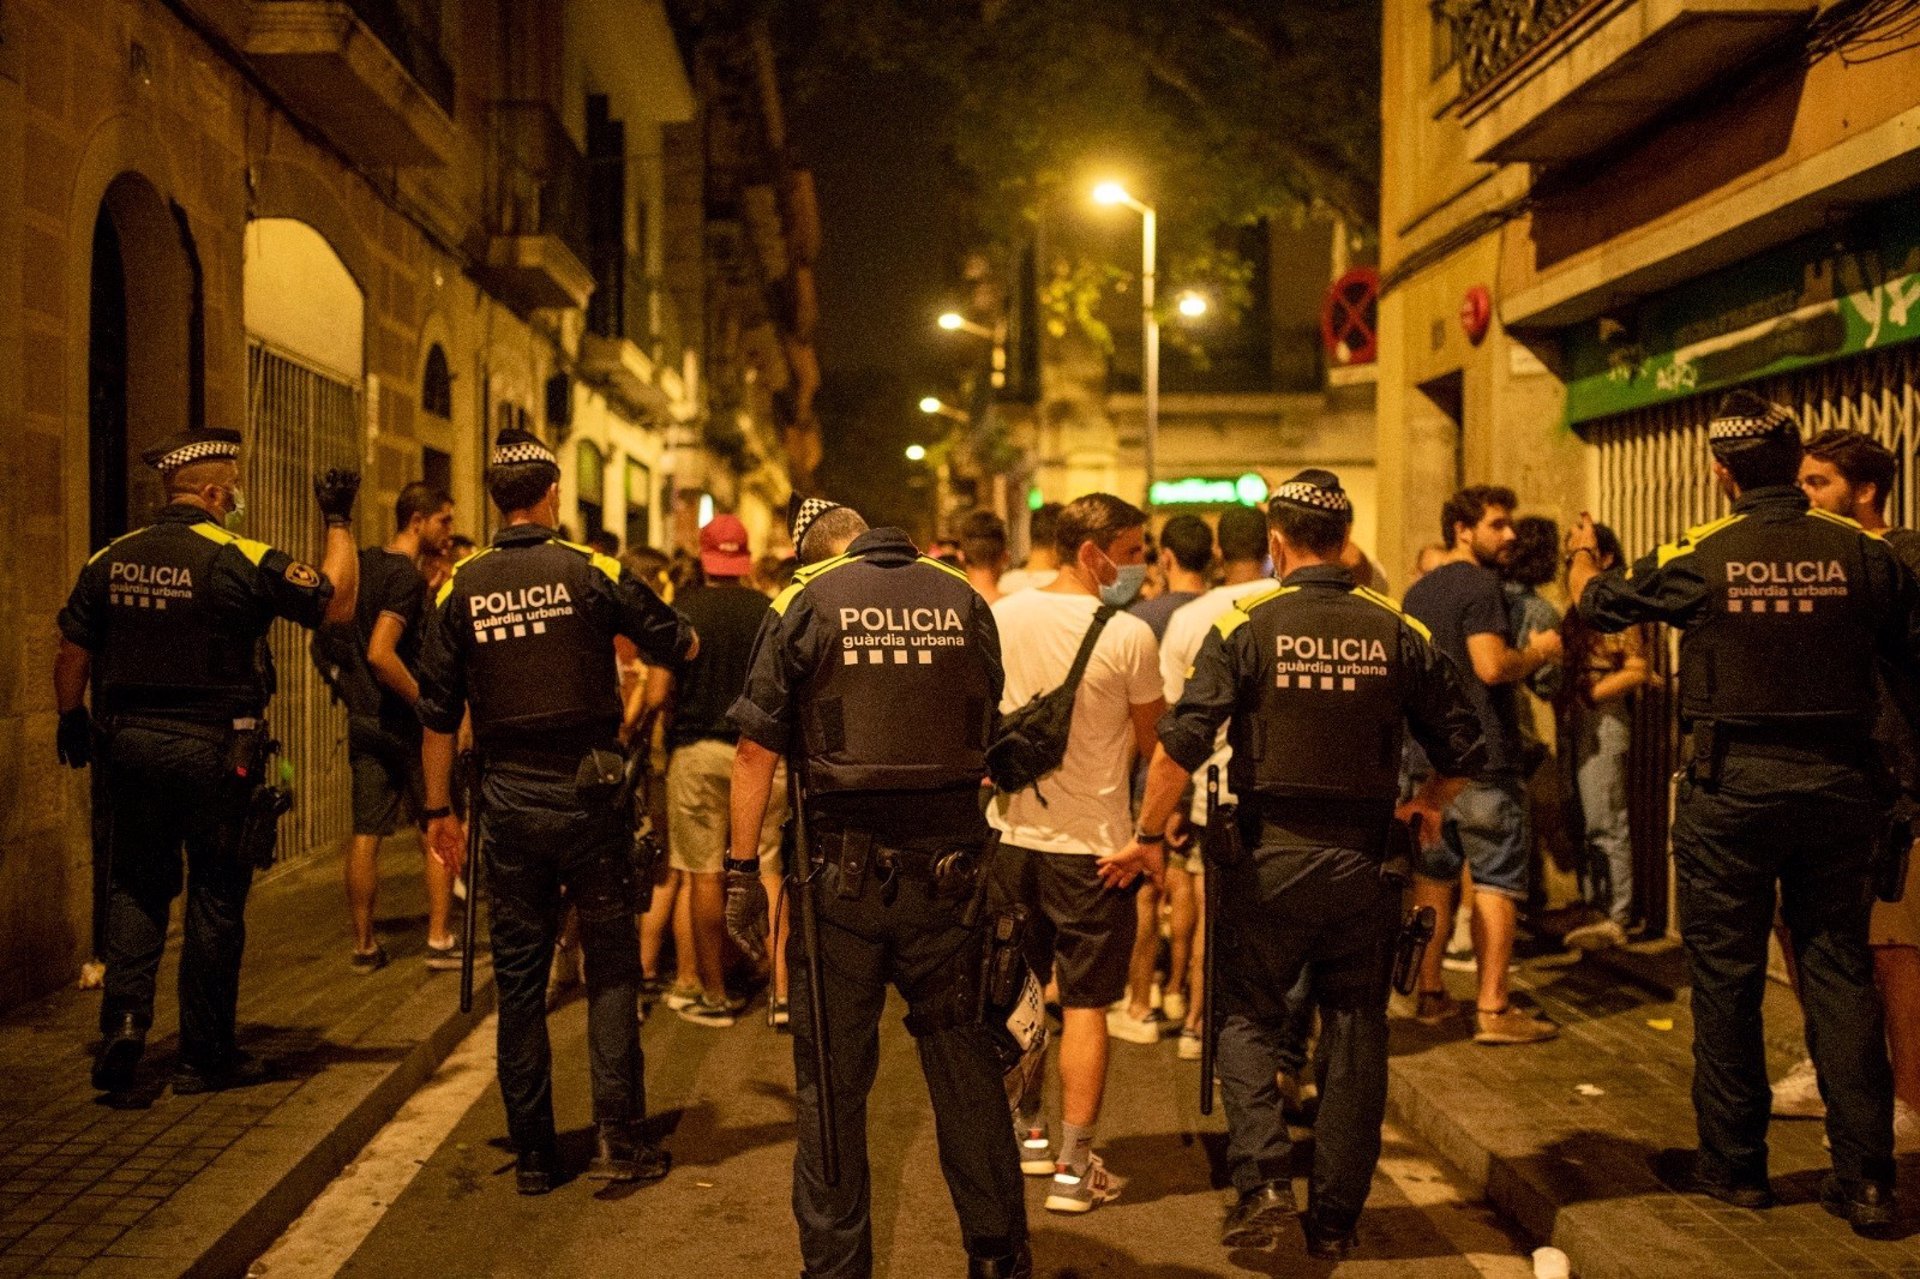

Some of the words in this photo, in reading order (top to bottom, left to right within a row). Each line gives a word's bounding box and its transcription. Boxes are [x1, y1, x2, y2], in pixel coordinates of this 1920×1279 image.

[110, 562, 192, 587] POLICIA
[1726, 561, 1847, 583] POLICIA
[469, 583, 571, 617] POLICIA
[1792, 585, 1848, 596] urbana
[473, 612, 523, 631] guàrdia
[526, 606, 573, 621] urbana
[840, 607, 963, 631] POLICIA
[842, 633, 906, 649] guàrdia
[911, 634, 965, 646] urbana
[1276, 635, 1388, 662] POLICIA
[1277, 660, 1333, 674] guàrdia
[1337, 663, 1387, 676] urbana
